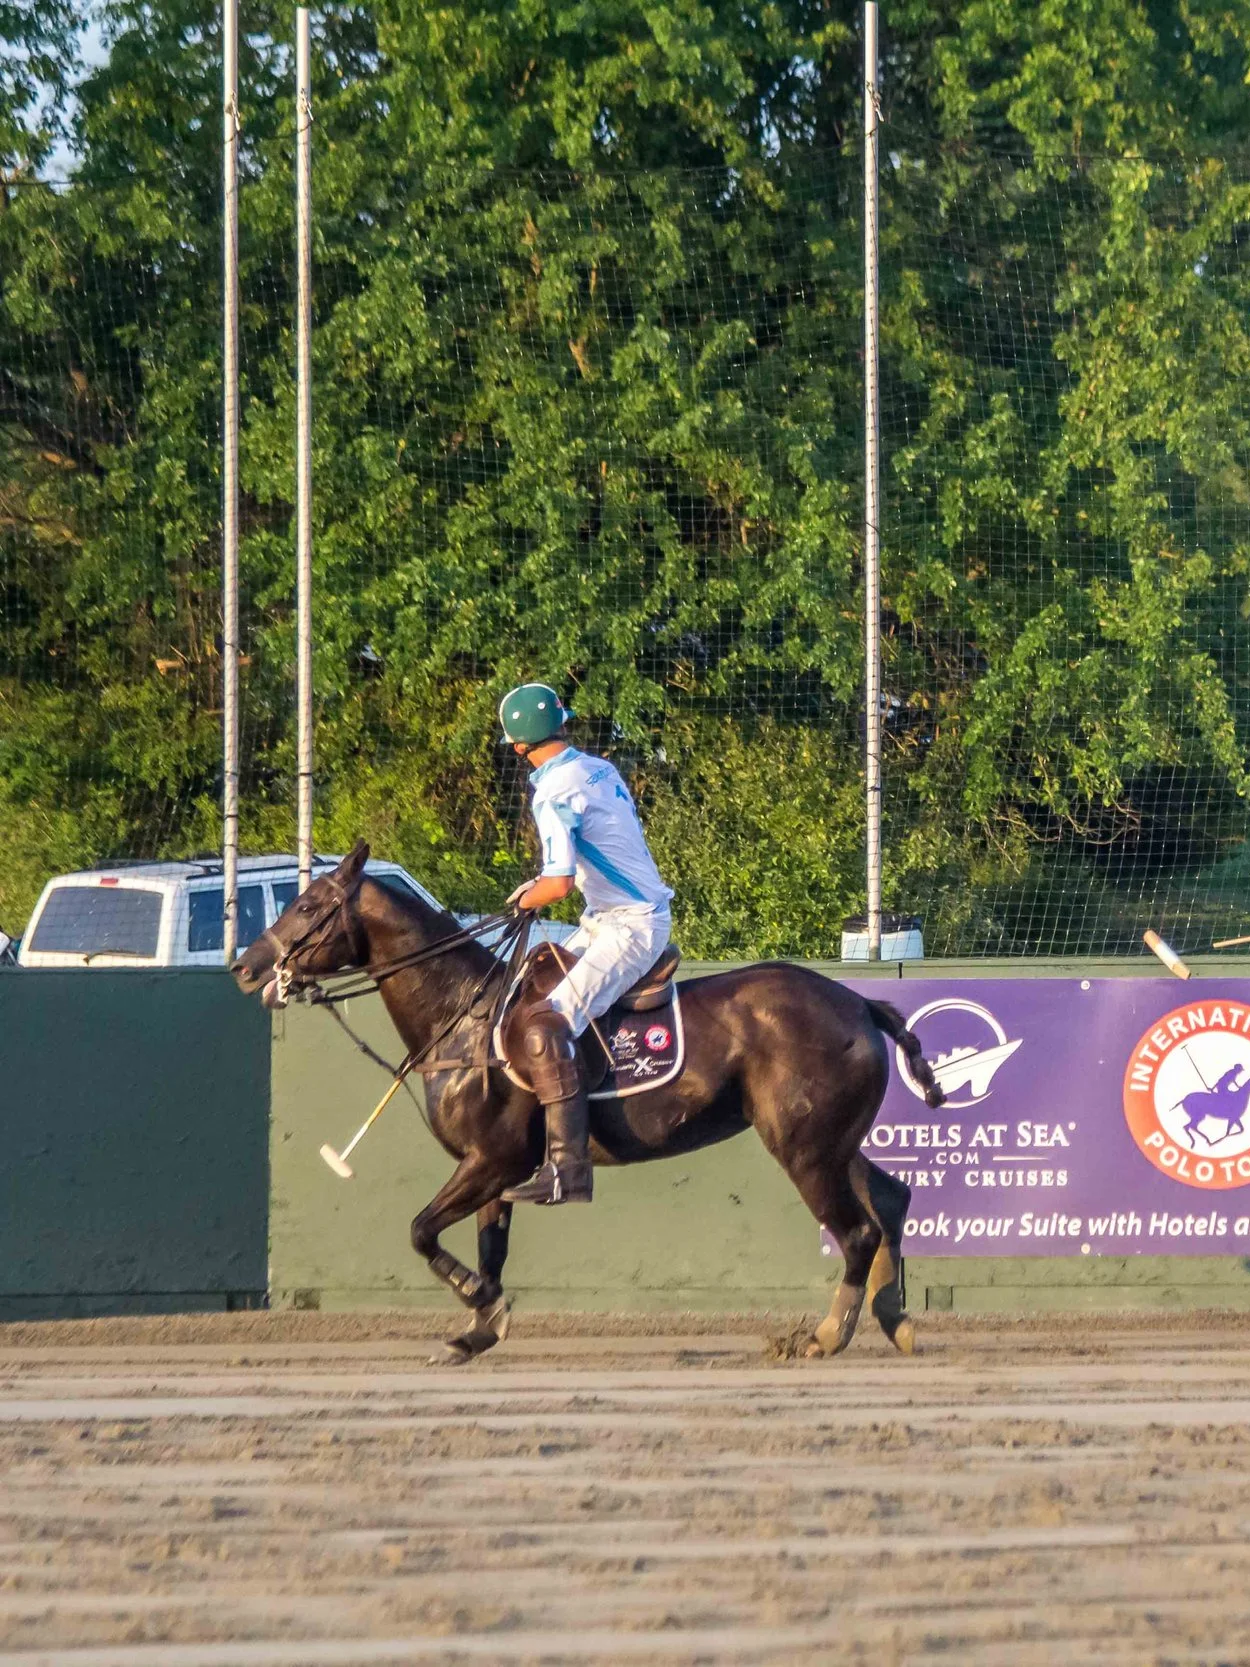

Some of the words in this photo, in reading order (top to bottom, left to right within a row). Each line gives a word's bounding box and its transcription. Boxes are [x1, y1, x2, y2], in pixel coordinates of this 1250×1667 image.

[968, 1124, 1008, 1148] AT
[928, 1151, 981, 1166] .COM
[1144, 1130, 1215, 1182] POLO
[888, 1170, 947, 1187] URY
[964, 1169, 1069, 1187] CRUISES
[903, 1211, 951, 1237] ook
[954, 1215, 1014, 1242] your
[1018, 1211, 1082, 1237] Suite
[1088, 1211, 1142, 1236] with
[1148, 1211, 1228, 1236] Hotels
